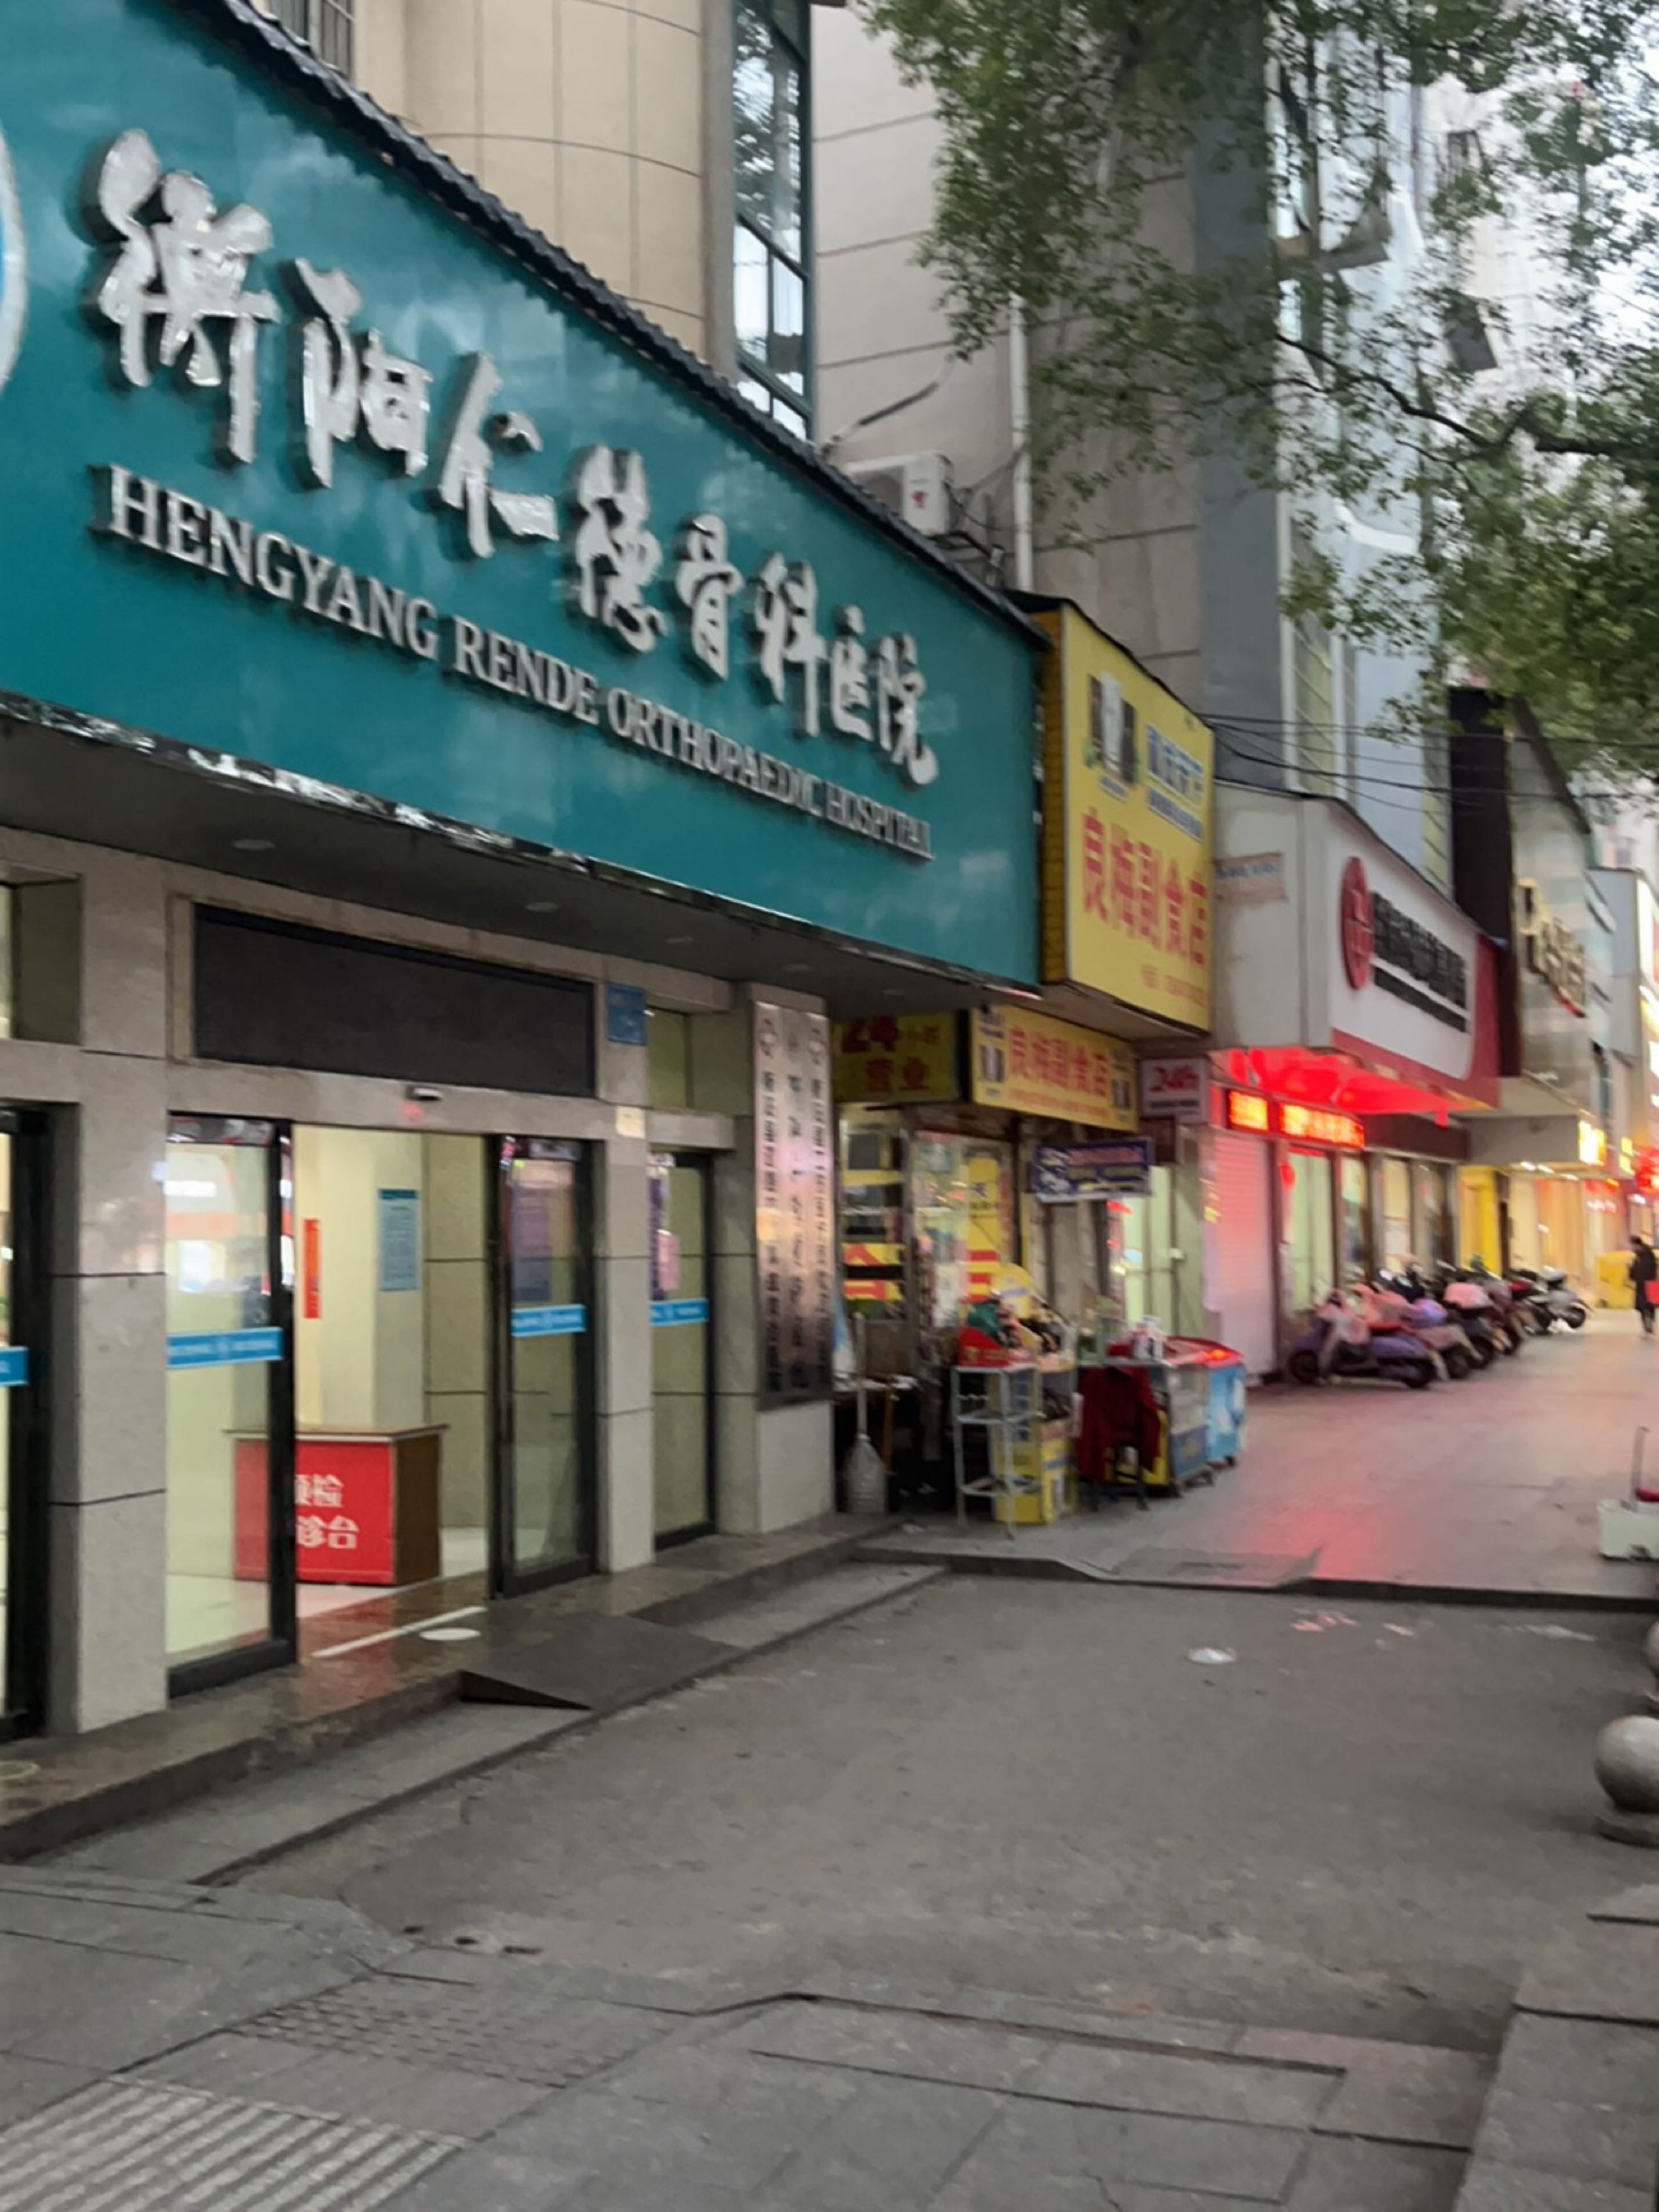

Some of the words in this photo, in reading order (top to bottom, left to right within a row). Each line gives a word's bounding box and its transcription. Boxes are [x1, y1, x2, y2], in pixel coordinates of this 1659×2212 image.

[102, 462, 440, 662] HENGYANG
[448, 614, 600, 727] RENDE
[605, 685, 826, 818] ORTHOPAEDIC
